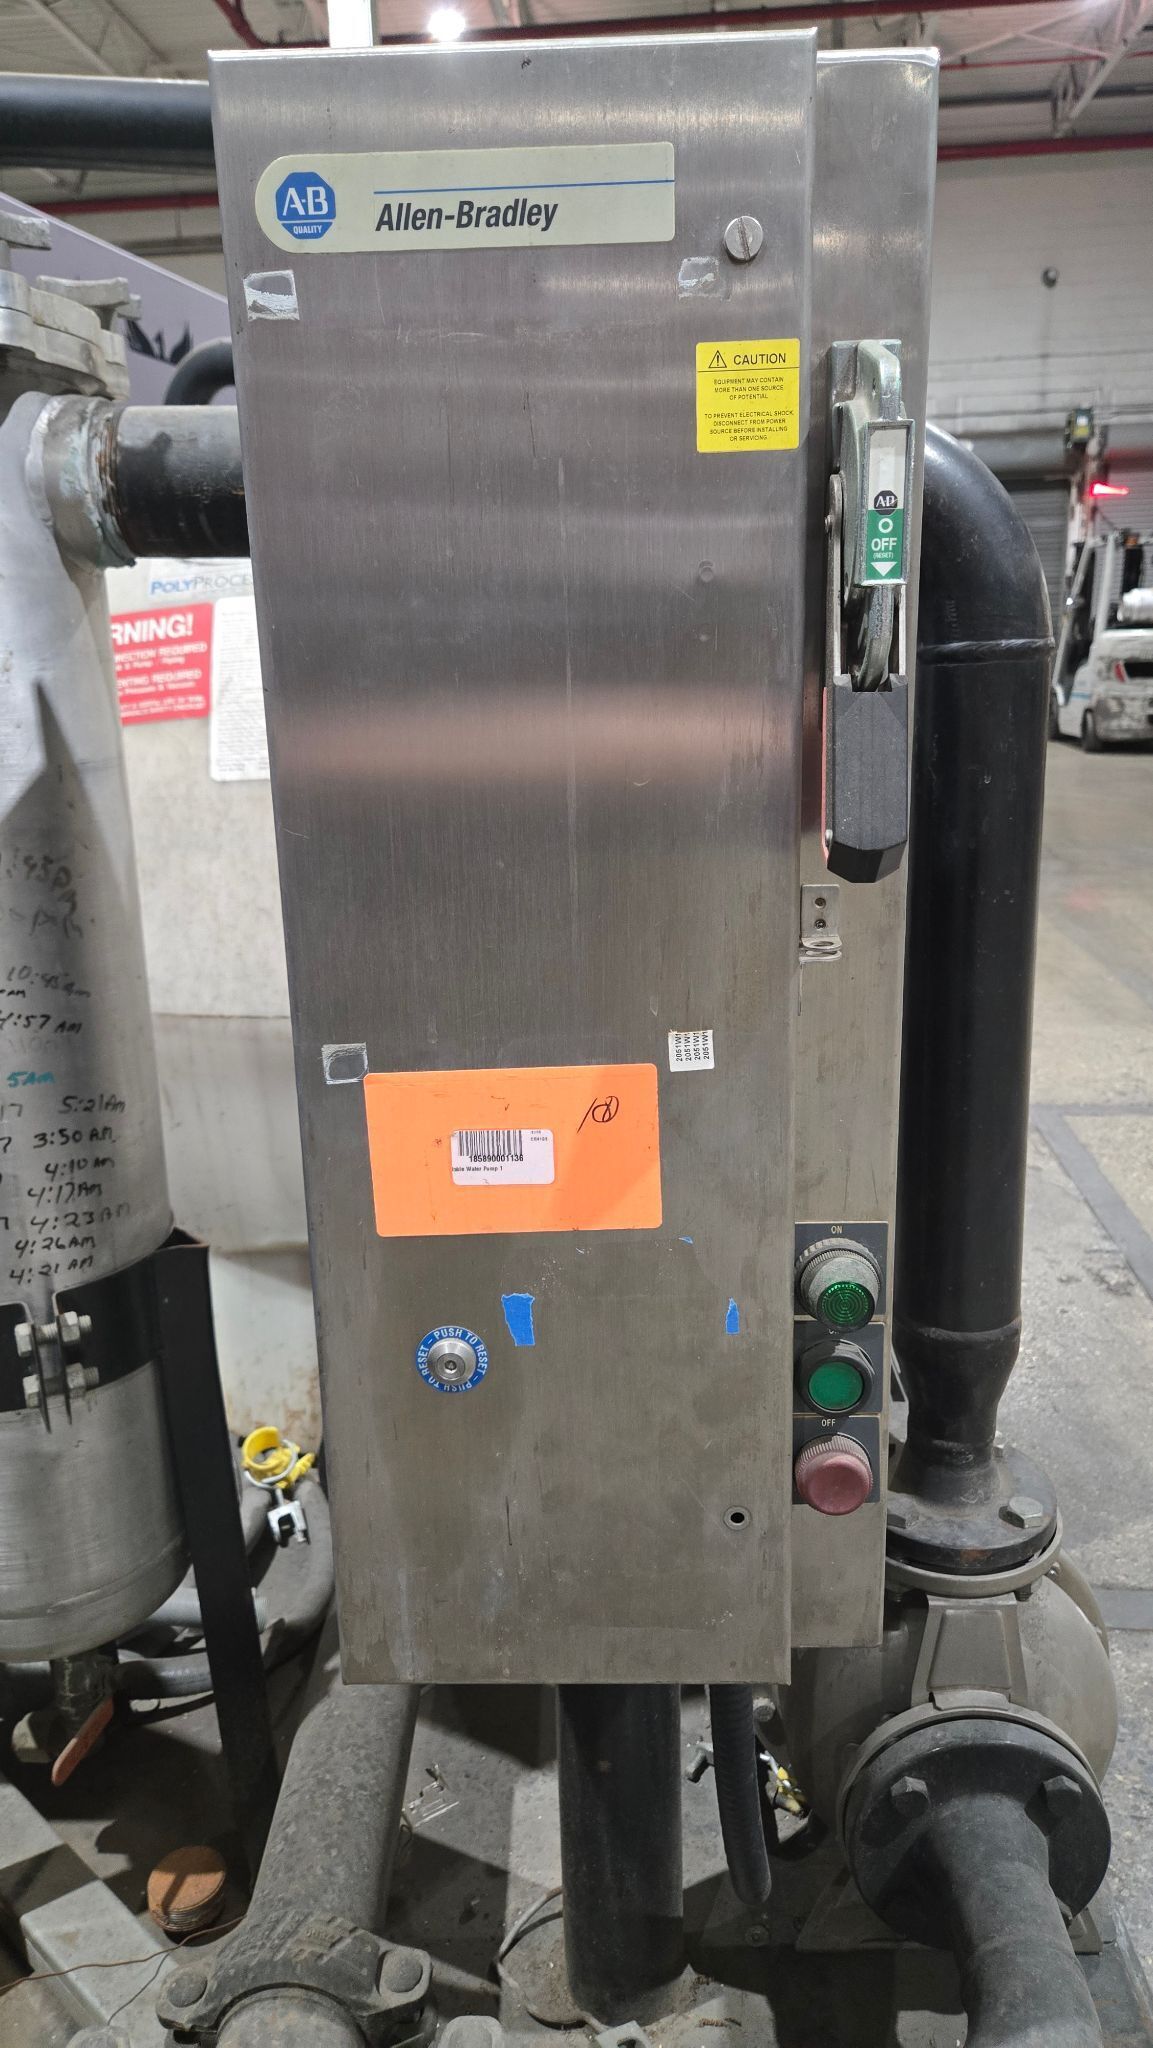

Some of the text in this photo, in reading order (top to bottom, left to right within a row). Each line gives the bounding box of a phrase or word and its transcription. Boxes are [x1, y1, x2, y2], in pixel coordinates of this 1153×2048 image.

[375, 198, 559, 232] Allen-Bradley
[293, 224, 323, 235] QUALITY
[733, 353, 787, 365] CAUTION
[713, 419, 748, 427] DISCONNECT
[871, 537, 898, 551] OFF
[33, 1128, 83, 1149] 3:50
[45, 1158, 88, 1181] 4:10
[30, 1211, 95, 1234] 4:23
[831, 1225, 842, 1234] ON
[9, 1255, 94, 1285] 4:21 AM
[433, 1328, 488, 1375] PUSH TO RESET
[417, 1345, 430, 1376] RESET
[427, 1376, 440, 1389] TO
[821, 1419, 836, 1427] OFF
